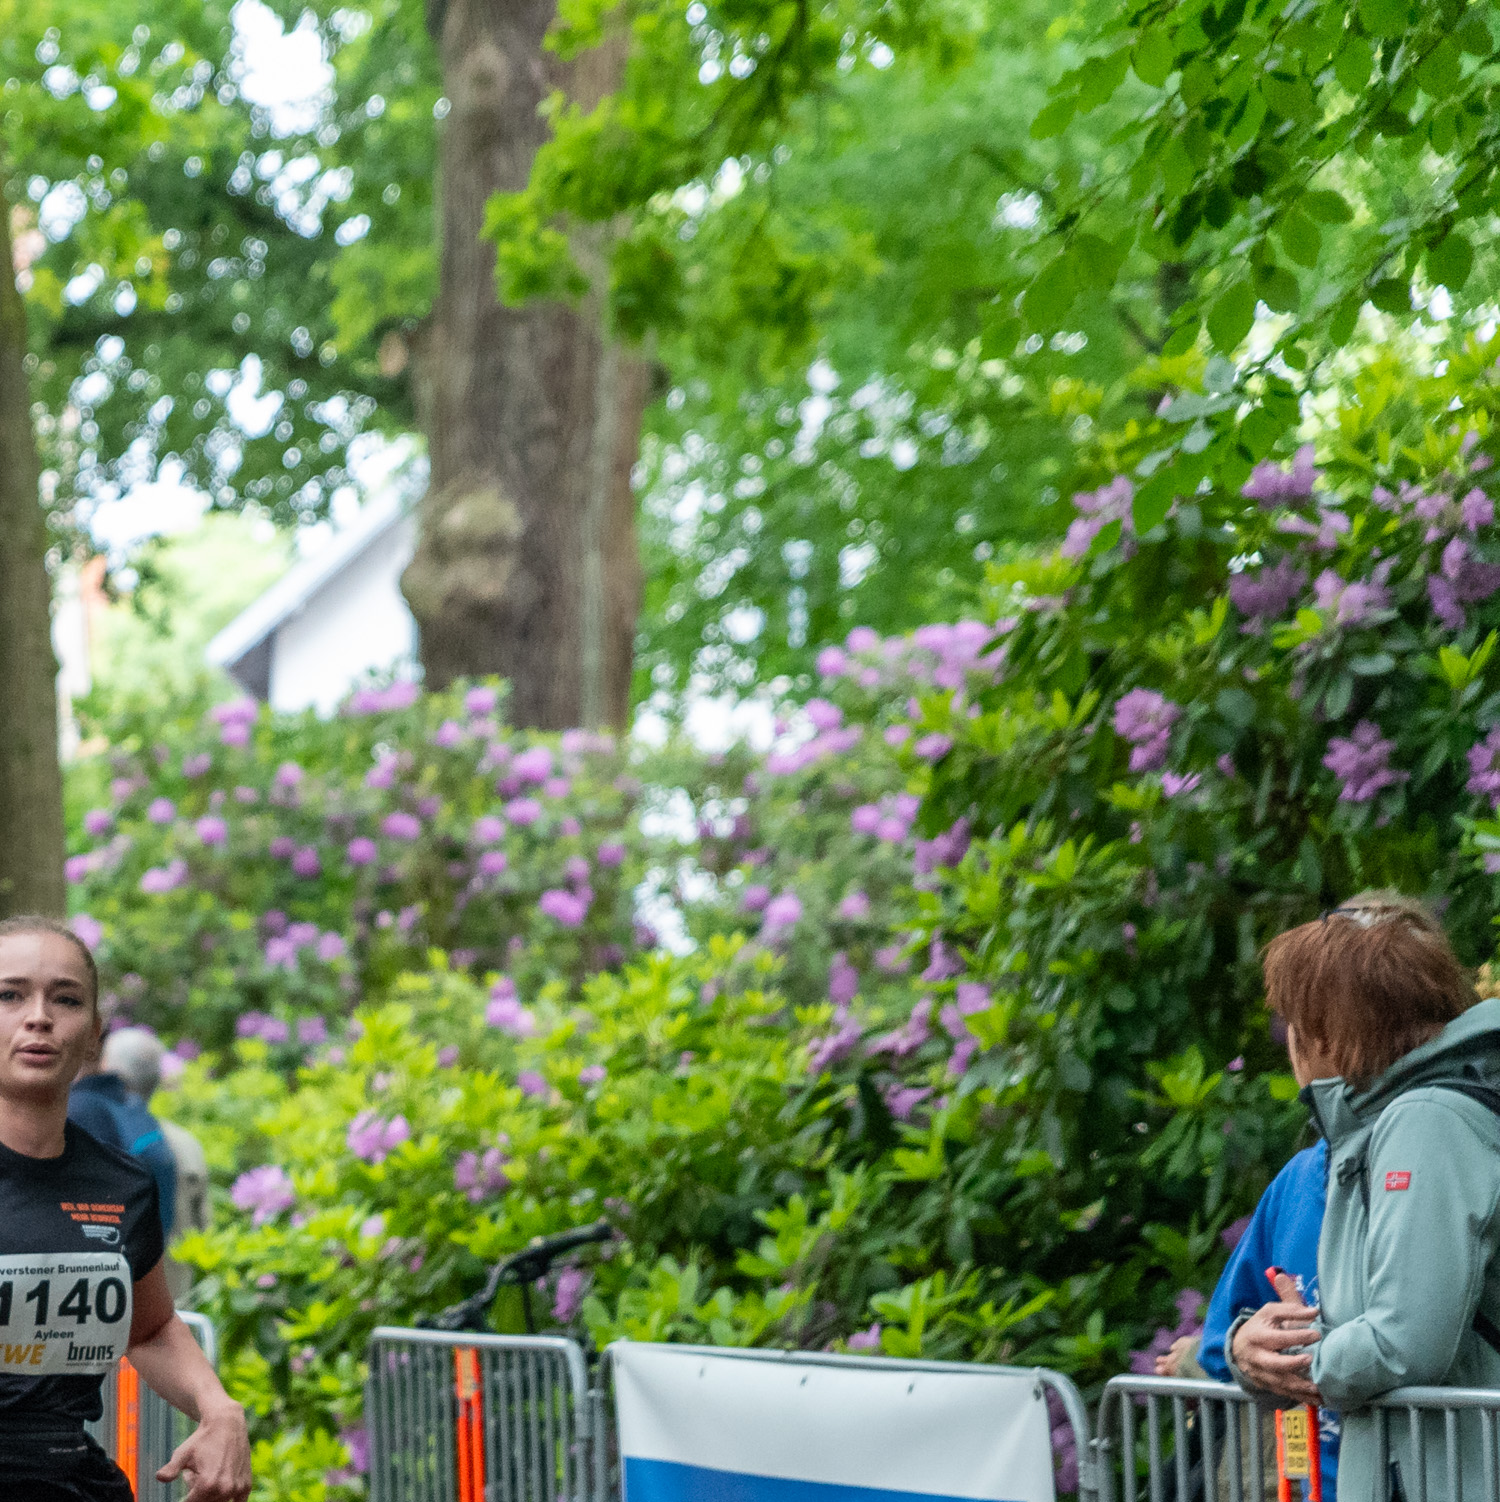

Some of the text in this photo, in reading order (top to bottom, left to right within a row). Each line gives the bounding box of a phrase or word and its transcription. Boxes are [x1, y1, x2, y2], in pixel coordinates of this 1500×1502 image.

[58, 1261, 120, 1274] Brunnenlauf
[34, 1329, 74, 1341] Ayleen
[67, 1341, 116, 1361] bruns
